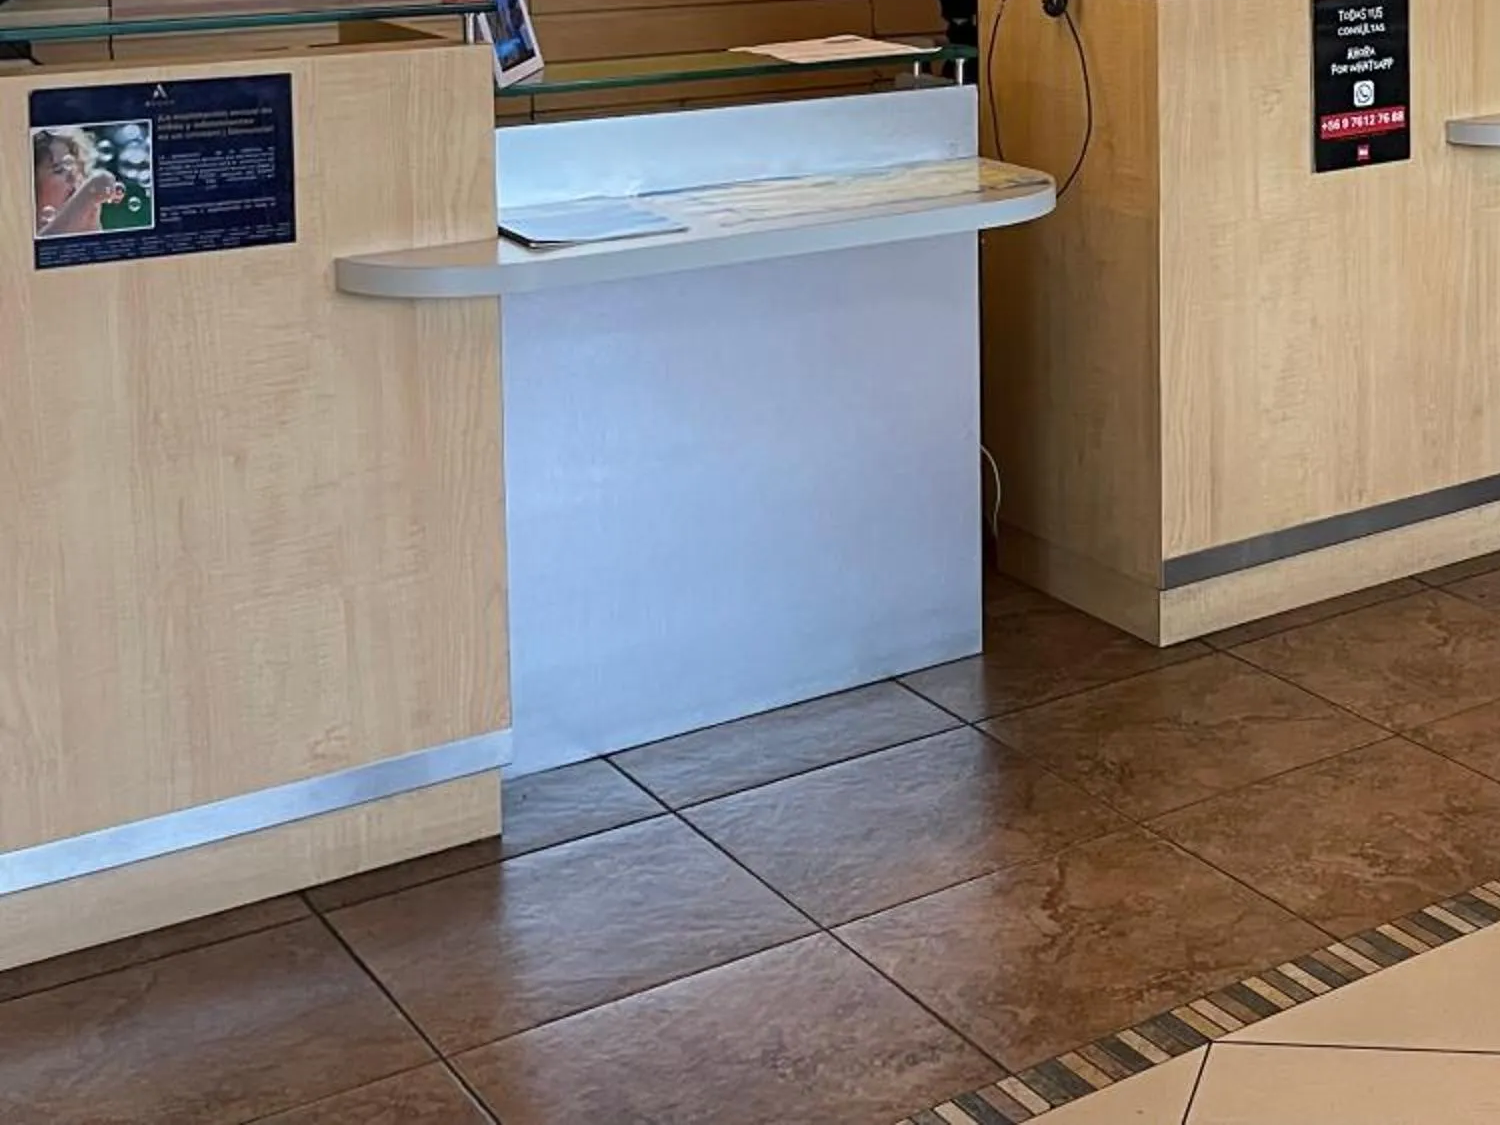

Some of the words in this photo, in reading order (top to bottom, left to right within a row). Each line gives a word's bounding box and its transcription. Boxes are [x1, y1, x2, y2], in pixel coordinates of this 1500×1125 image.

[1338, 7, 1366, 22] TODAS
[1337, 23, 1385, 36] CONSULTAS
[1346, 45, 1376, 59] AHORA
[1331, 63, 1348, 75] POR
